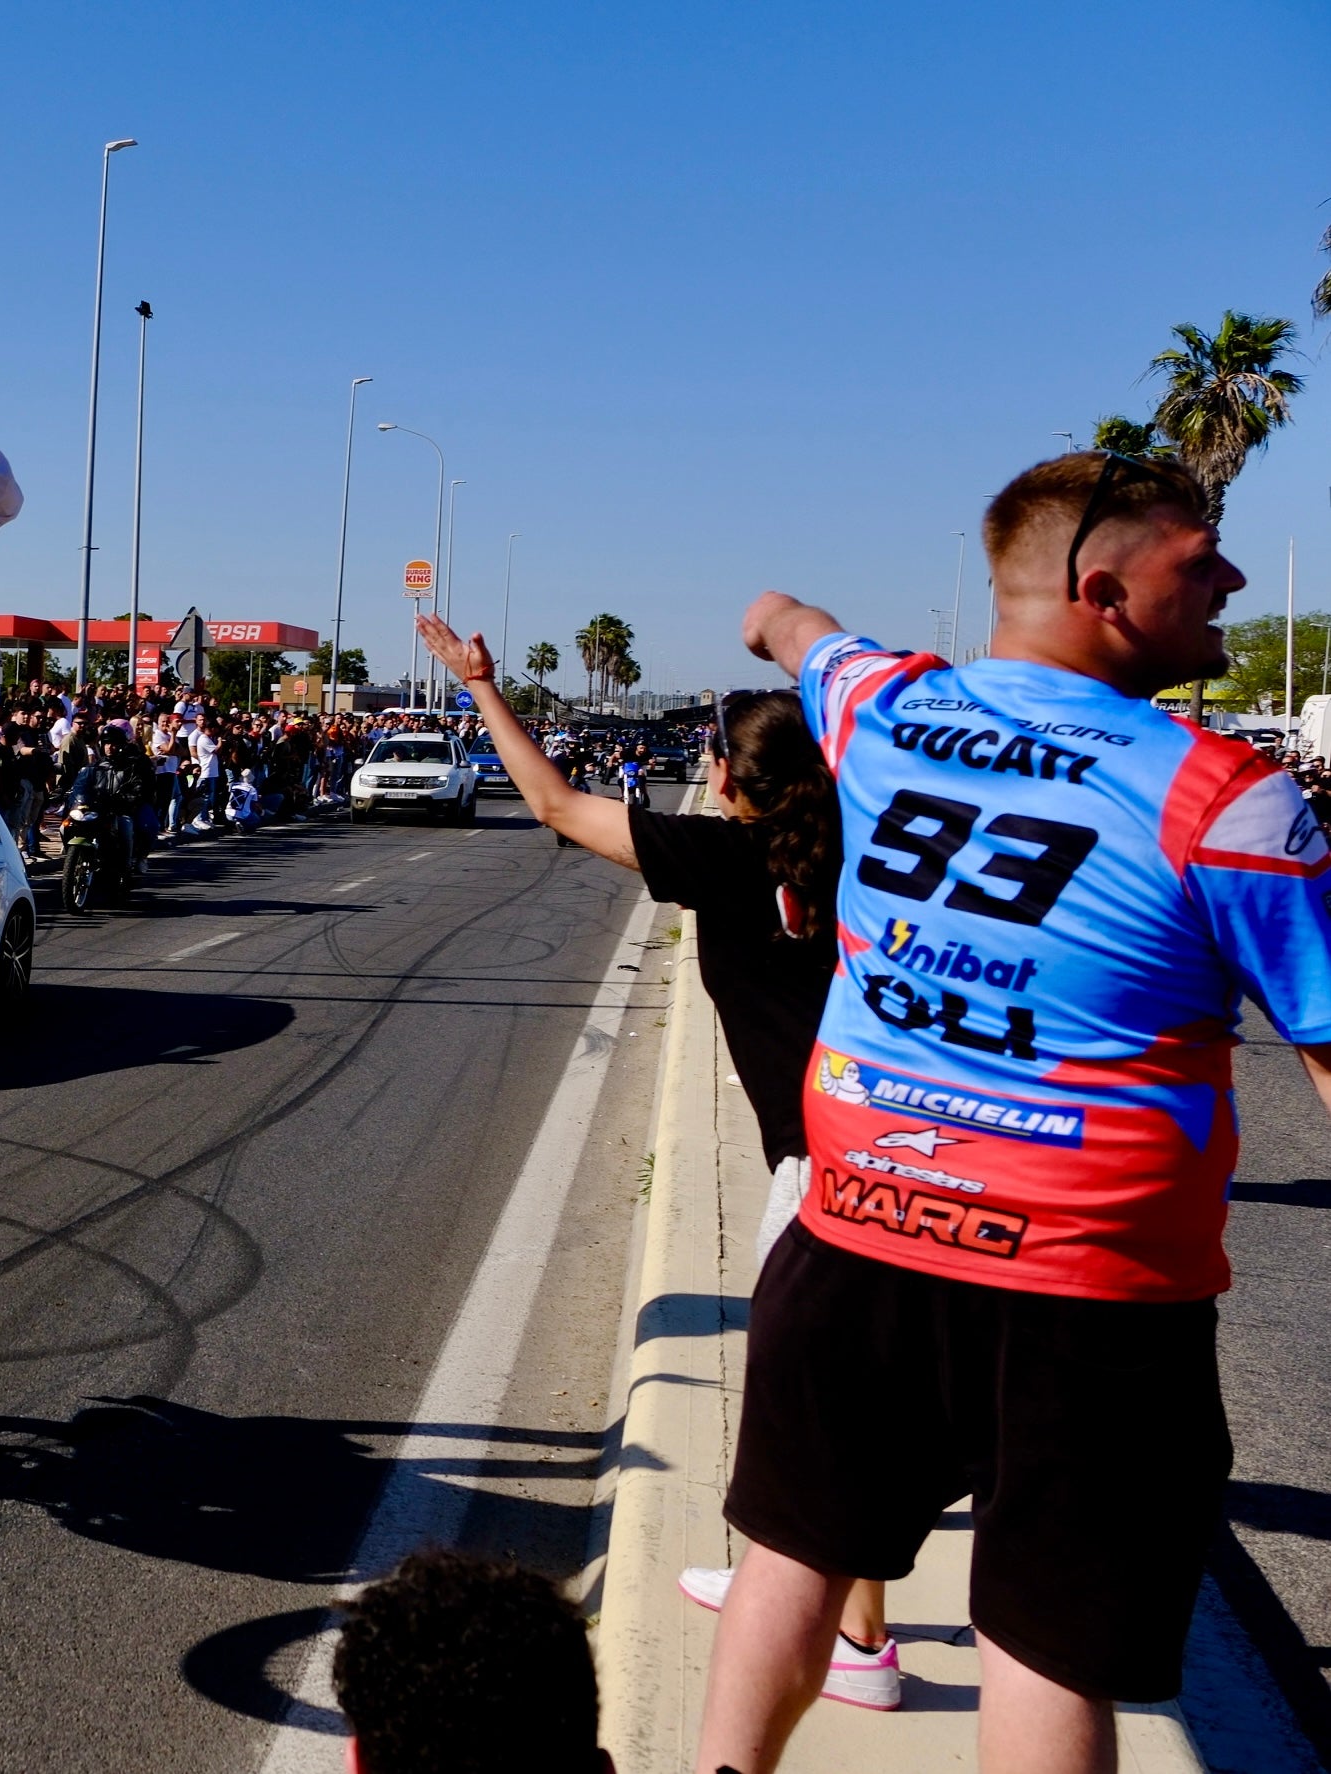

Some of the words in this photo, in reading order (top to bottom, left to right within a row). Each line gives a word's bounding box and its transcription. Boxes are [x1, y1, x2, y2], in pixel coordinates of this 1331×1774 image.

[405, 575, 432, 583] KING
[209, 624, 262, 641] EPSA
[891, 722, 1100, 785] DUCATI
[857, 788, 1100, 928] 93
[878, 917, 1039, 993] Unibat
[871, 1078, 1080, 1136] MICHELIN
[843, 1149, 987, 1195] alpinestars
[822, 1167, 1030, 1260] MARC
